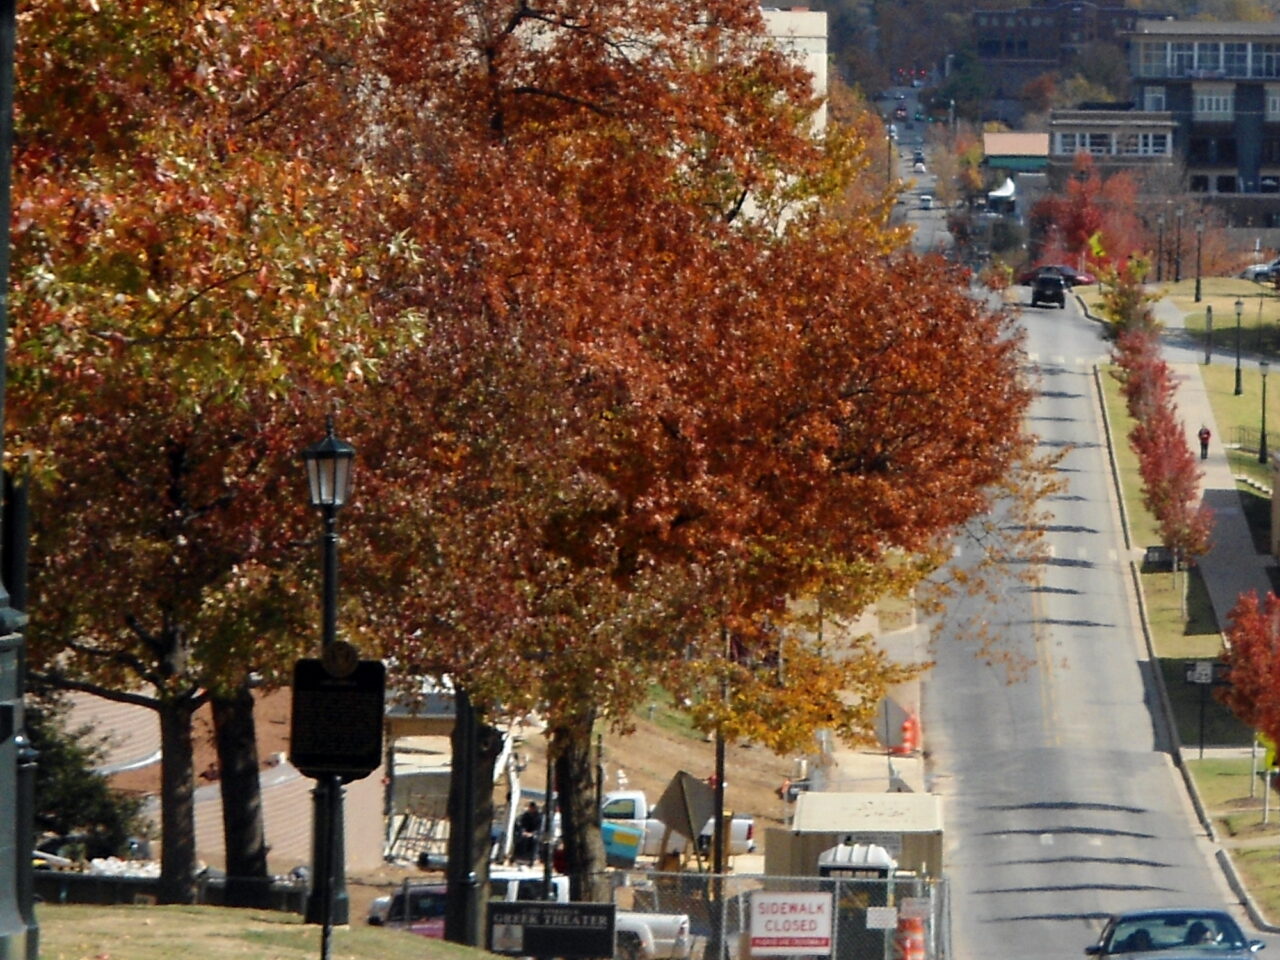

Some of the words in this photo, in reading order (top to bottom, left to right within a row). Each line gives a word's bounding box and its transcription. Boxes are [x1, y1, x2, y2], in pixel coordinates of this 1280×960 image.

[758, 902, 824, 914] SIDEWALK
[493, 913, 538, 924] GREEK
[543, 915, 608, 926] THEATER
[764, 919, 817, 931] CLOSED
